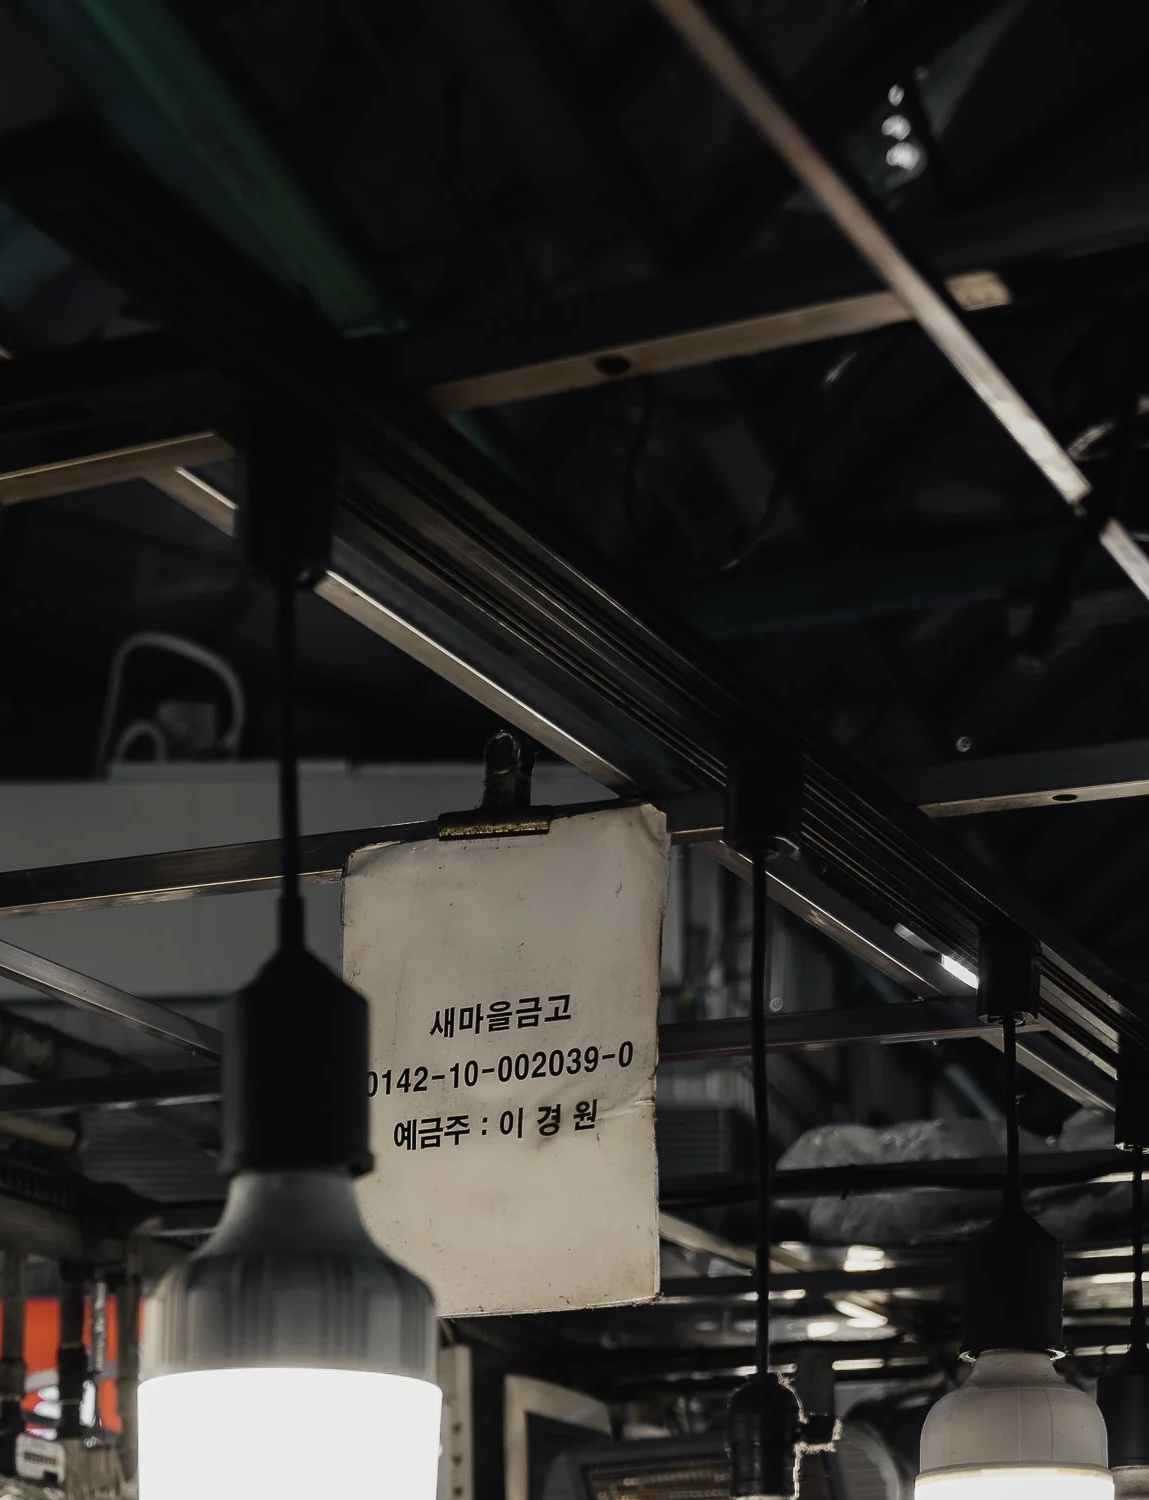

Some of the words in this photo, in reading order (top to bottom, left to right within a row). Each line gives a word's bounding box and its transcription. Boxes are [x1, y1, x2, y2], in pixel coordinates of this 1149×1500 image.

[429, 994, 572, 1039] 새마을금고
[366, 1041, 634, 1098] 0142-10-002039-0
[393, 1114, 470, 1151] 예금주
